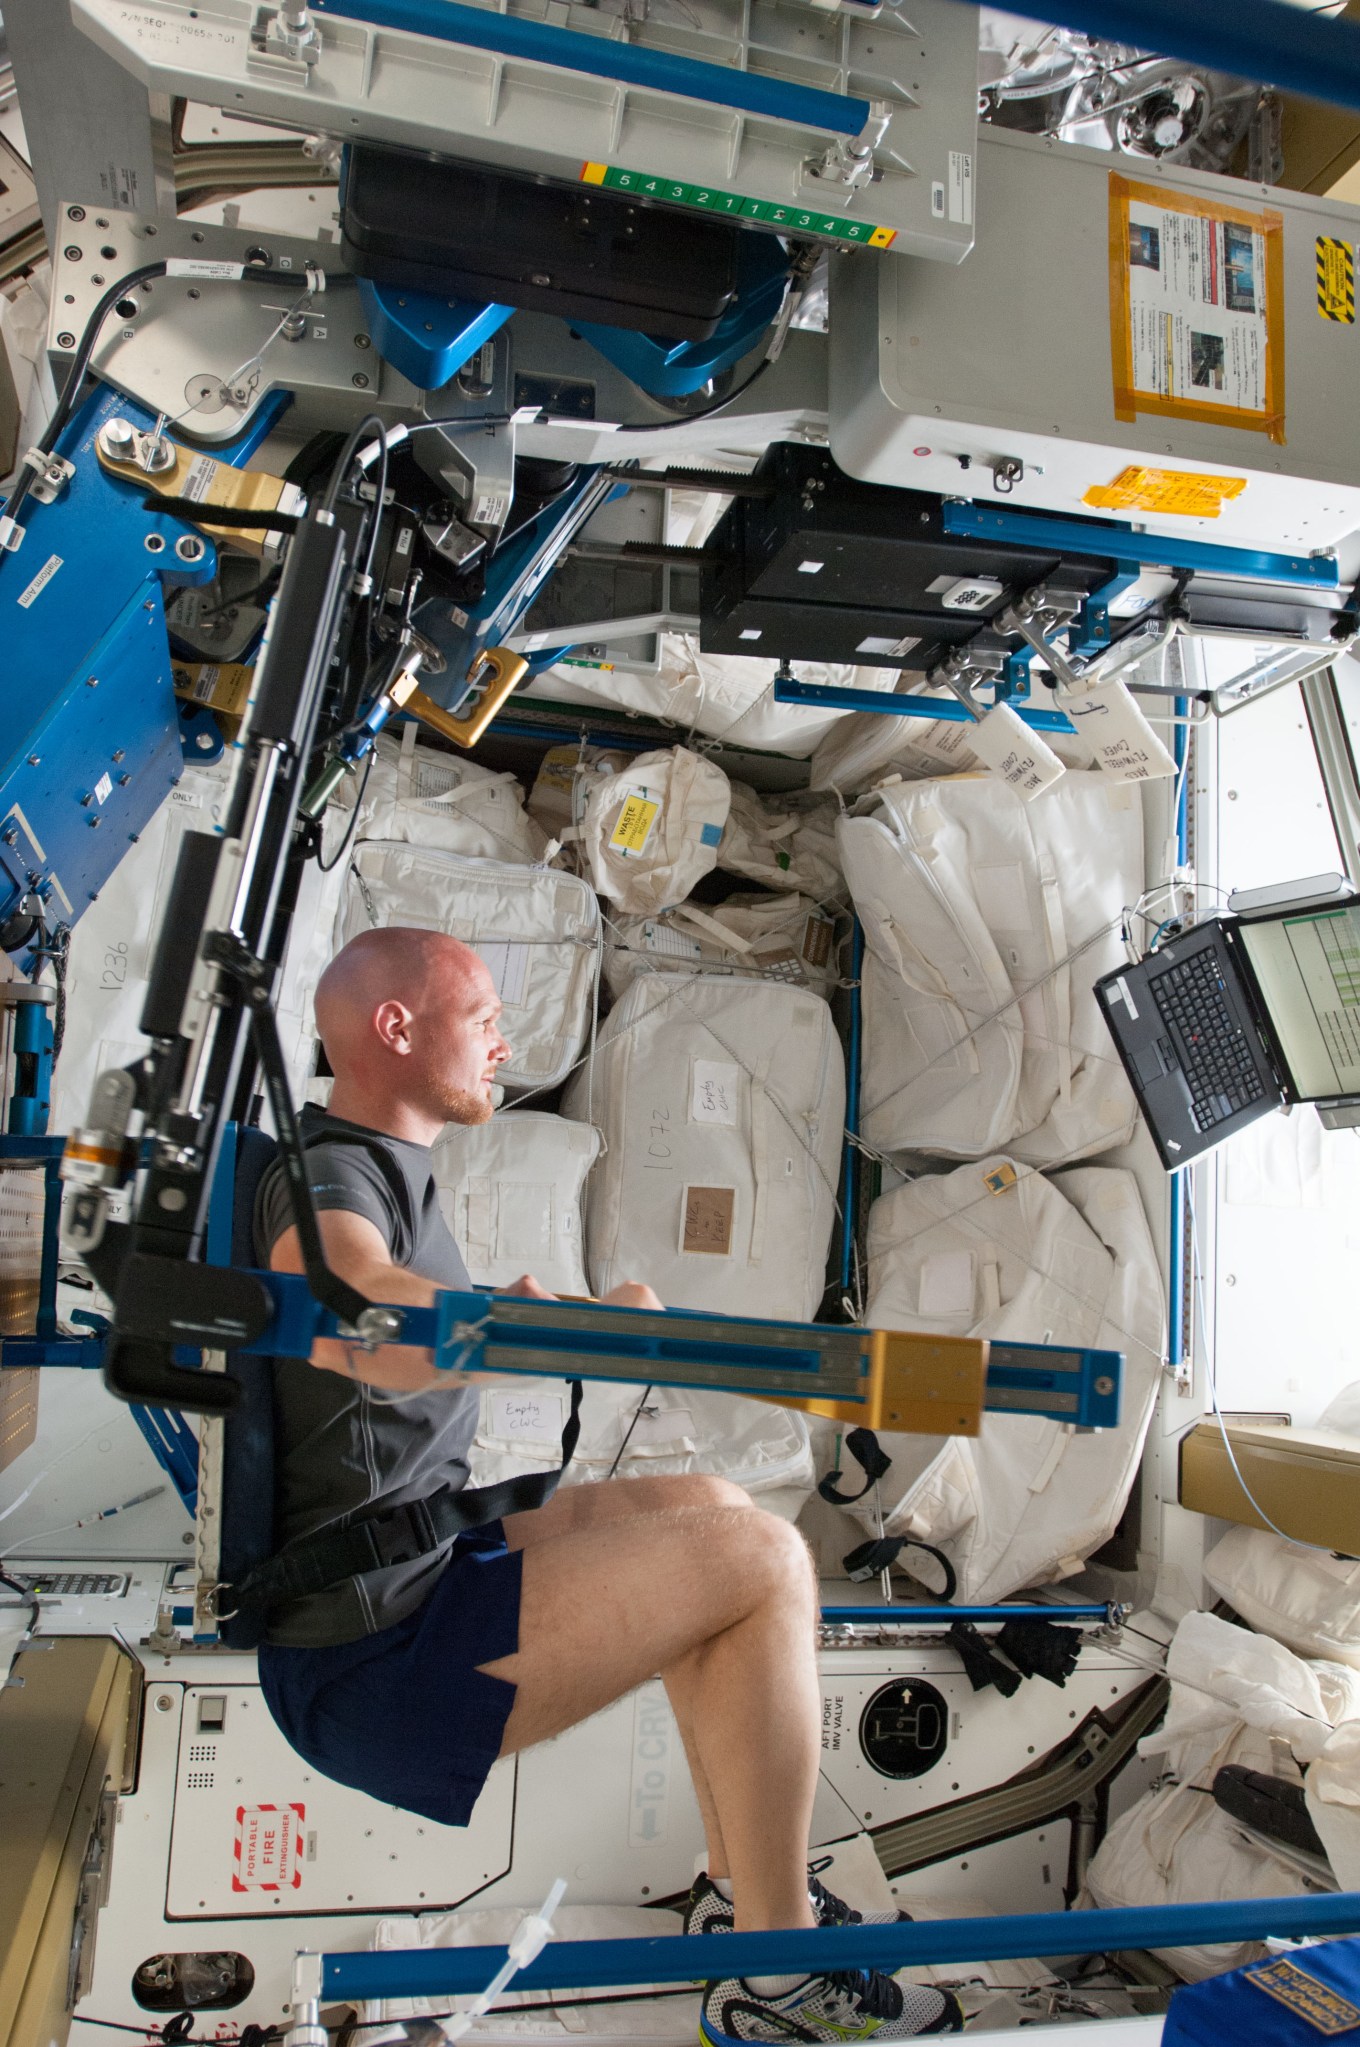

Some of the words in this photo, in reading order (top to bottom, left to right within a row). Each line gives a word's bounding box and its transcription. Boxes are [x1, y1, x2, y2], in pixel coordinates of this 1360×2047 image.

[620, 175, 630, 186] 5
[646, 181, 656, 191] 4
[672, 187, 682, 197] 3
[698, 192, 709, 203] 2
[727, 198, 733, 208] 1
[752, 204, 758, 214] 1
[800, 215, 810, 226] 3
[824, 221, 834, 231] 4
[849, 226, 859, 237] 5
[281, 259, 290, 268] C
[317, 329, 325, 337] A
[34, 556, 61, 587] Platform
[20, 587, 37, 604] Arm
[1102, 739, 1130, 757] COVER
[1104, 749, 1149, 769] FLYWHEEL
[172, 792, 193, 803] ONLY
[618, 805, 636, 836] WASTE
[637, 818, 648, 835] ВОДА
[99, 941, 128, 990] 1236
[643, 1104, 674, 1171] 1072
[505, 1401, 540, 1416] Empty
[823, 1697, 833, 1727] PORT
[833, 1695, 844, 1732] VALVE
[821, 1729, 831, 1750] AFT
[832, 1733, 841, 1751] IMV
[635, 1769, 665, 1809] To
[247, 1819, 258, 1877] PORTABLE
[263, 1830, 275, 1864] FIRE
[280, 1814, 290, 1879] EXTINGUISHER
